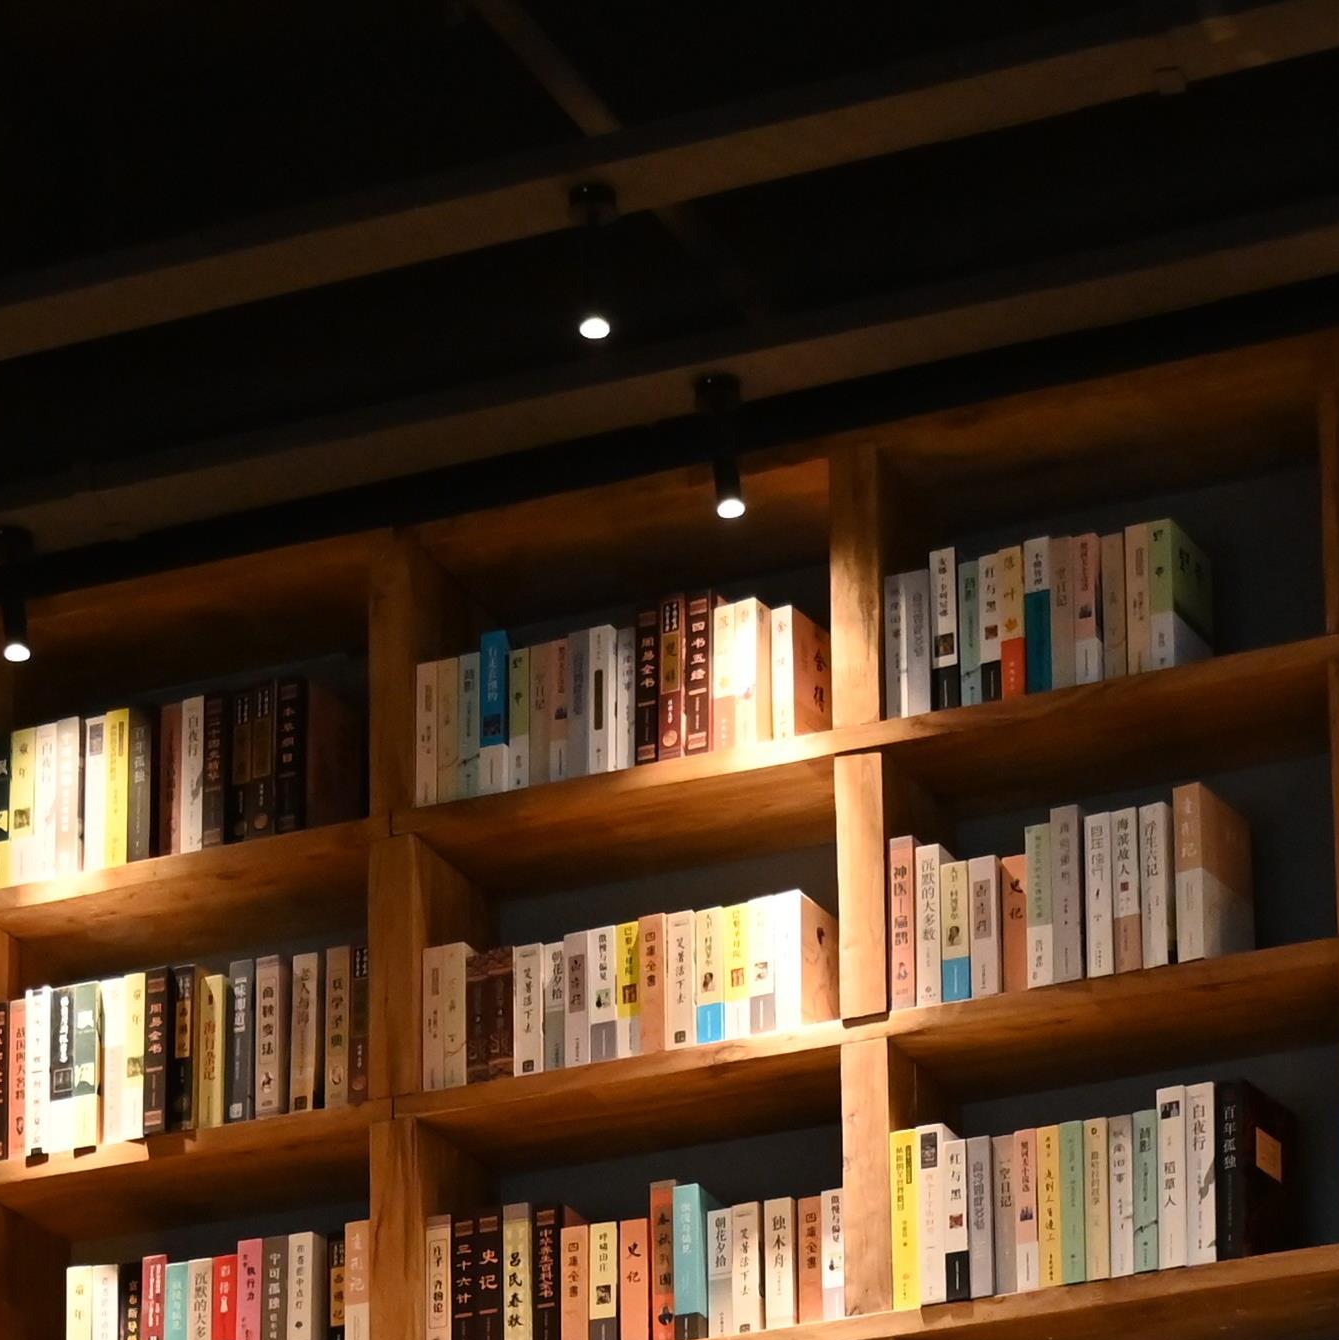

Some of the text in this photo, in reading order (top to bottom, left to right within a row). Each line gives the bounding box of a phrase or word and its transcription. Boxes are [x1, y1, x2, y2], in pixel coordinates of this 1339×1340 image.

[690, 620, 707, 682] 四书五经
[188, 715, 199, 757] 白夜行
[1117, 818, 1130, 875] 海滨故人
[1144, 821, 1159, 877] 浮生六记
[921, 859, 936, 942] 沉默的大多数
[1009, 878, 1023, 921] 史记
[261, 985, 275, 1056] 商鞅变法
[296, 967, 310, 1027] 老人与海
[147, 1003, 163, 1054] 周易全书
[1192, 1104, 1206, 1152] 白夜行
[1224, 1105, 1236, 1169] 百年孤独
[950, 1153, 962, 1200] 红与黑
[1163, 1161, 1176, 1208] 稻草人
[537, 1228, 555, 1298] 中华养生百科全书
[626, 1242, 641, 1284] 史记
[714, 1216, 727, 1269] 朝花夕拾
[772, 1215, 787, 1269] 独木舟
[455, 1244, 473, 1305] 三十六计
[479, 1250, 498, 1290] 史记
[508, 1252, 523, 1328] 吕氏春秋
